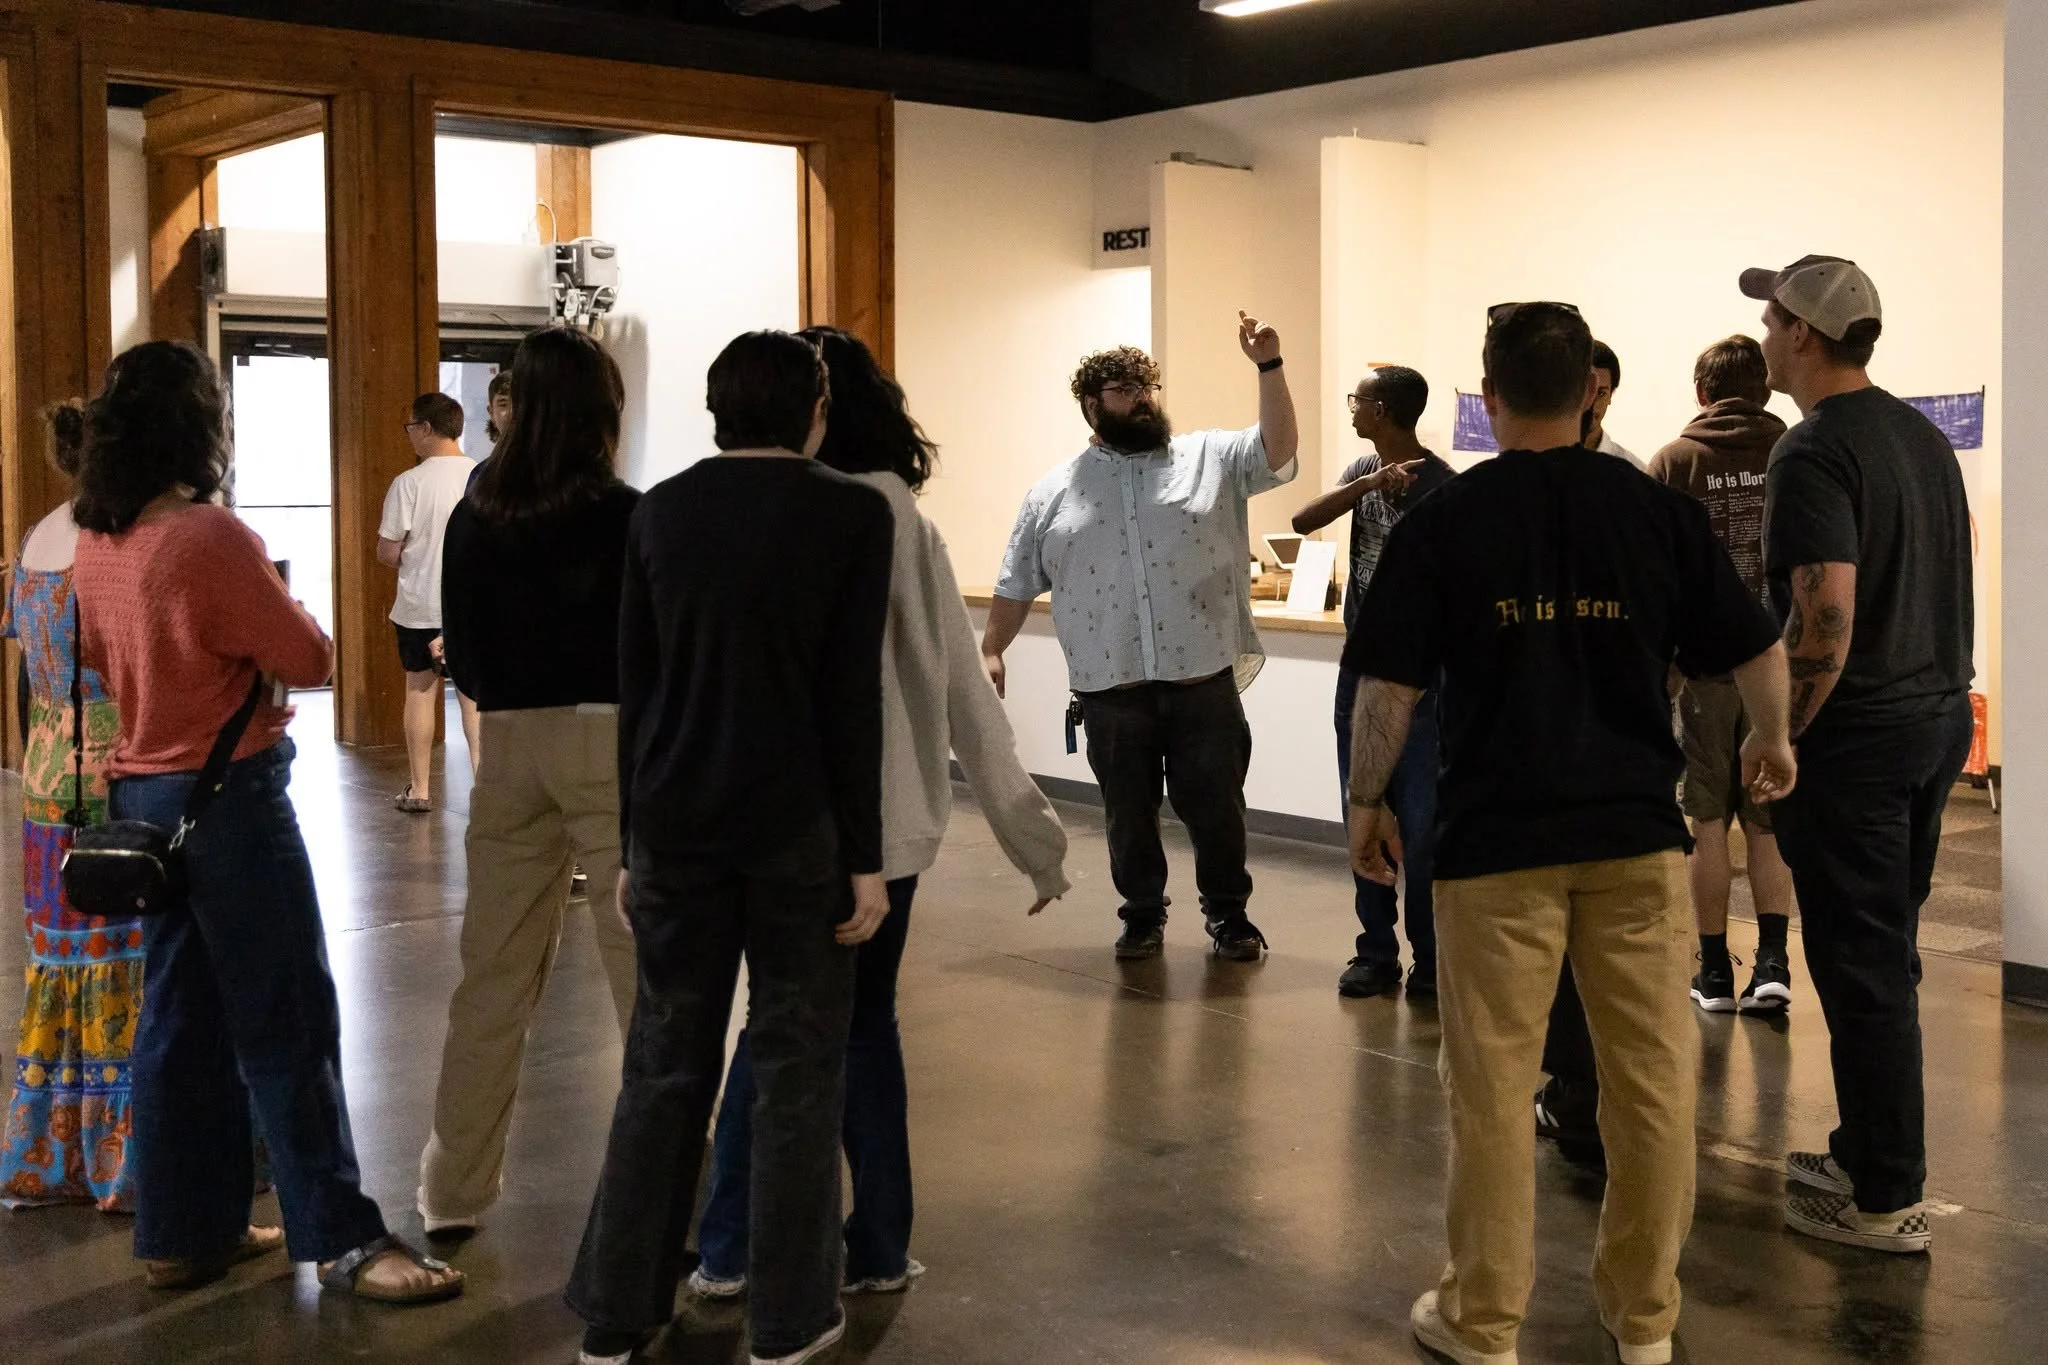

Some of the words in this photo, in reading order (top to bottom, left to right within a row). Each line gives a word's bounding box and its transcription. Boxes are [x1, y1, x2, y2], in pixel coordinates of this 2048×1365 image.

[1103, 227, 1150, 251] REST
[1706, 473, 1723, 491] He
[1725, 472, 1737, 488] is
[1739, 471, 1766, 487] Wor
[1495, 598, 1525, 627] H
[1535, 594, 1556, 621] is
[1567, 593, 1629, 620] sen.
